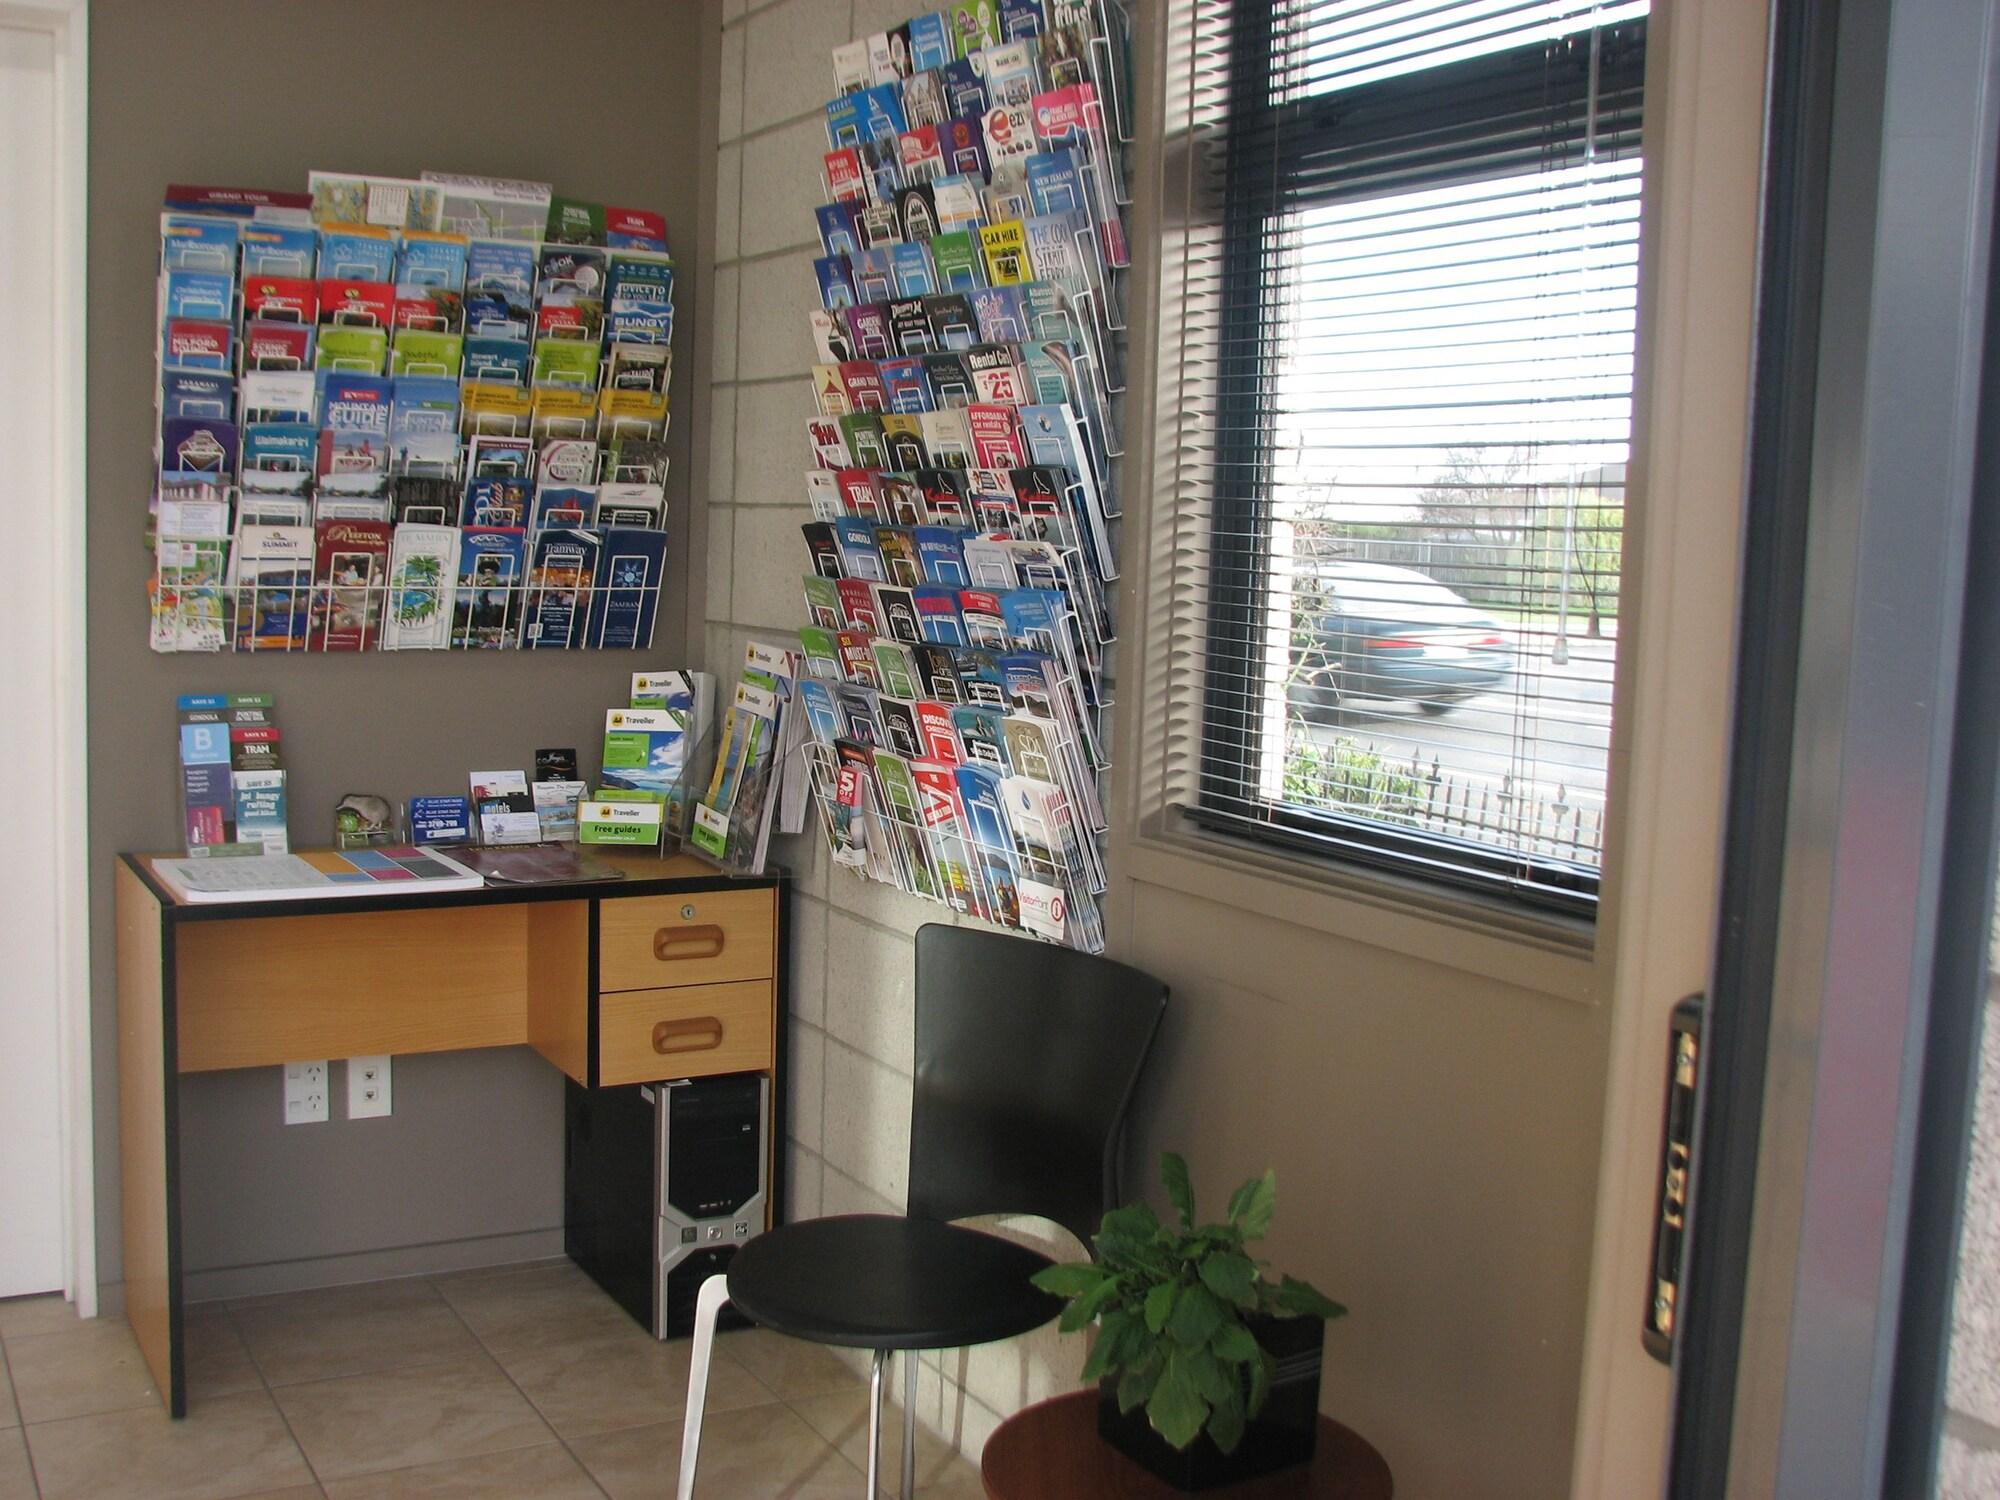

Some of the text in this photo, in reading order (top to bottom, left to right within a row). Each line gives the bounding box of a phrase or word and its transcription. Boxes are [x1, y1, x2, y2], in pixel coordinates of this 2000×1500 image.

[984, 228, 1018, 245] CAR HIRE
[615, 317, 667, 327] BUNGY
[969, 354, 996, 370] Rental
[328, 401, 389, 413] MOUNTAIN
[328, 410, 388, 425] GUIDE
[255, 435, 309, 448] Waimakariri
[848, 486, 874, 502] TRAM
[544, 544, 588, 555] Tramway
[626, 716, 656, 724] Traveller
[195, 728, 213, 751] B
[244, 745, 270, 754] TRAM
[840, 772, 854, 790] 5
[246, 801, 275, 809] rafting
[613, 809, 641, 817] Traveller
[594, 824, 642, 834] Free guides
